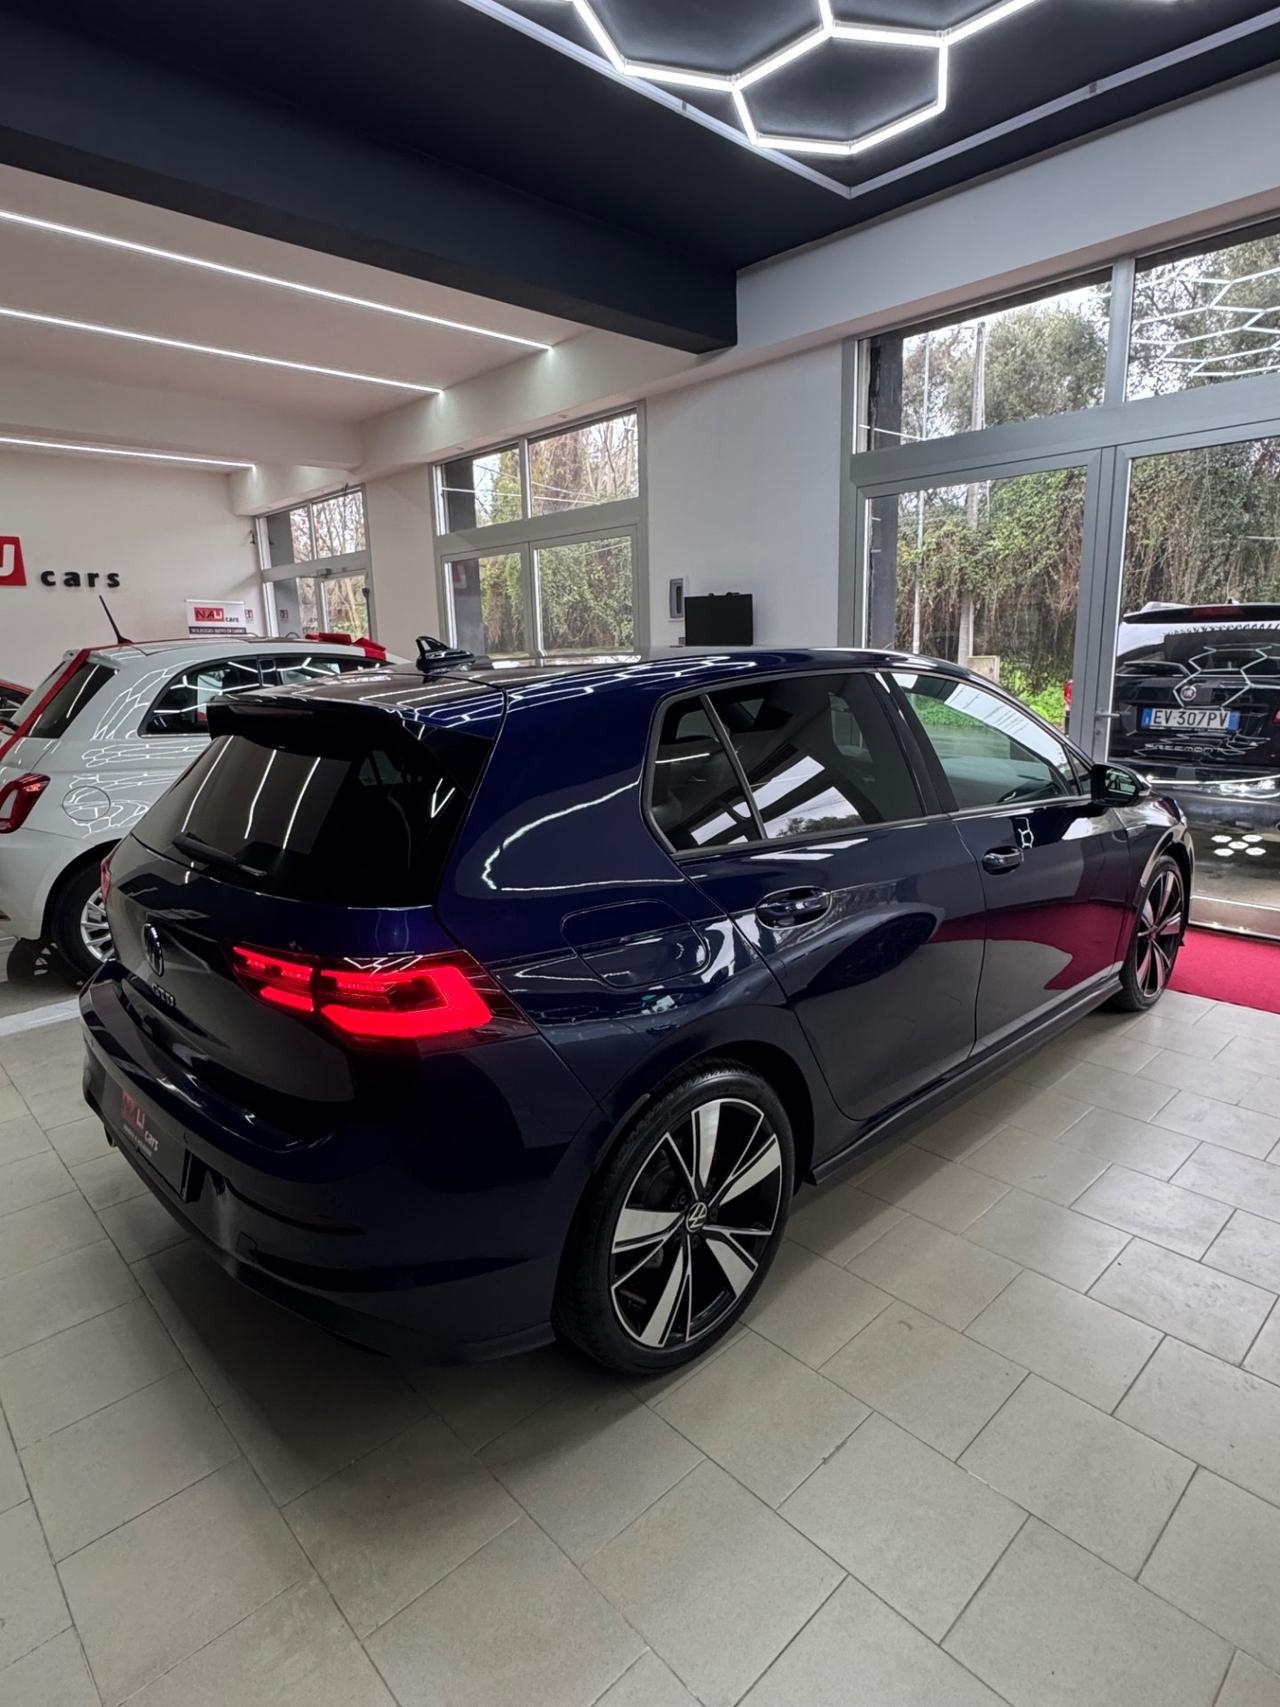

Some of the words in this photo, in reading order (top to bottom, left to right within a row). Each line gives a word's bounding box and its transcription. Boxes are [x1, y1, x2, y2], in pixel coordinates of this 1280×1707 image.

[40, 570, 120, 588] cars
[1153, 710, 1173, 725] EV
[1176, 711, 1228, 728] 307PV
